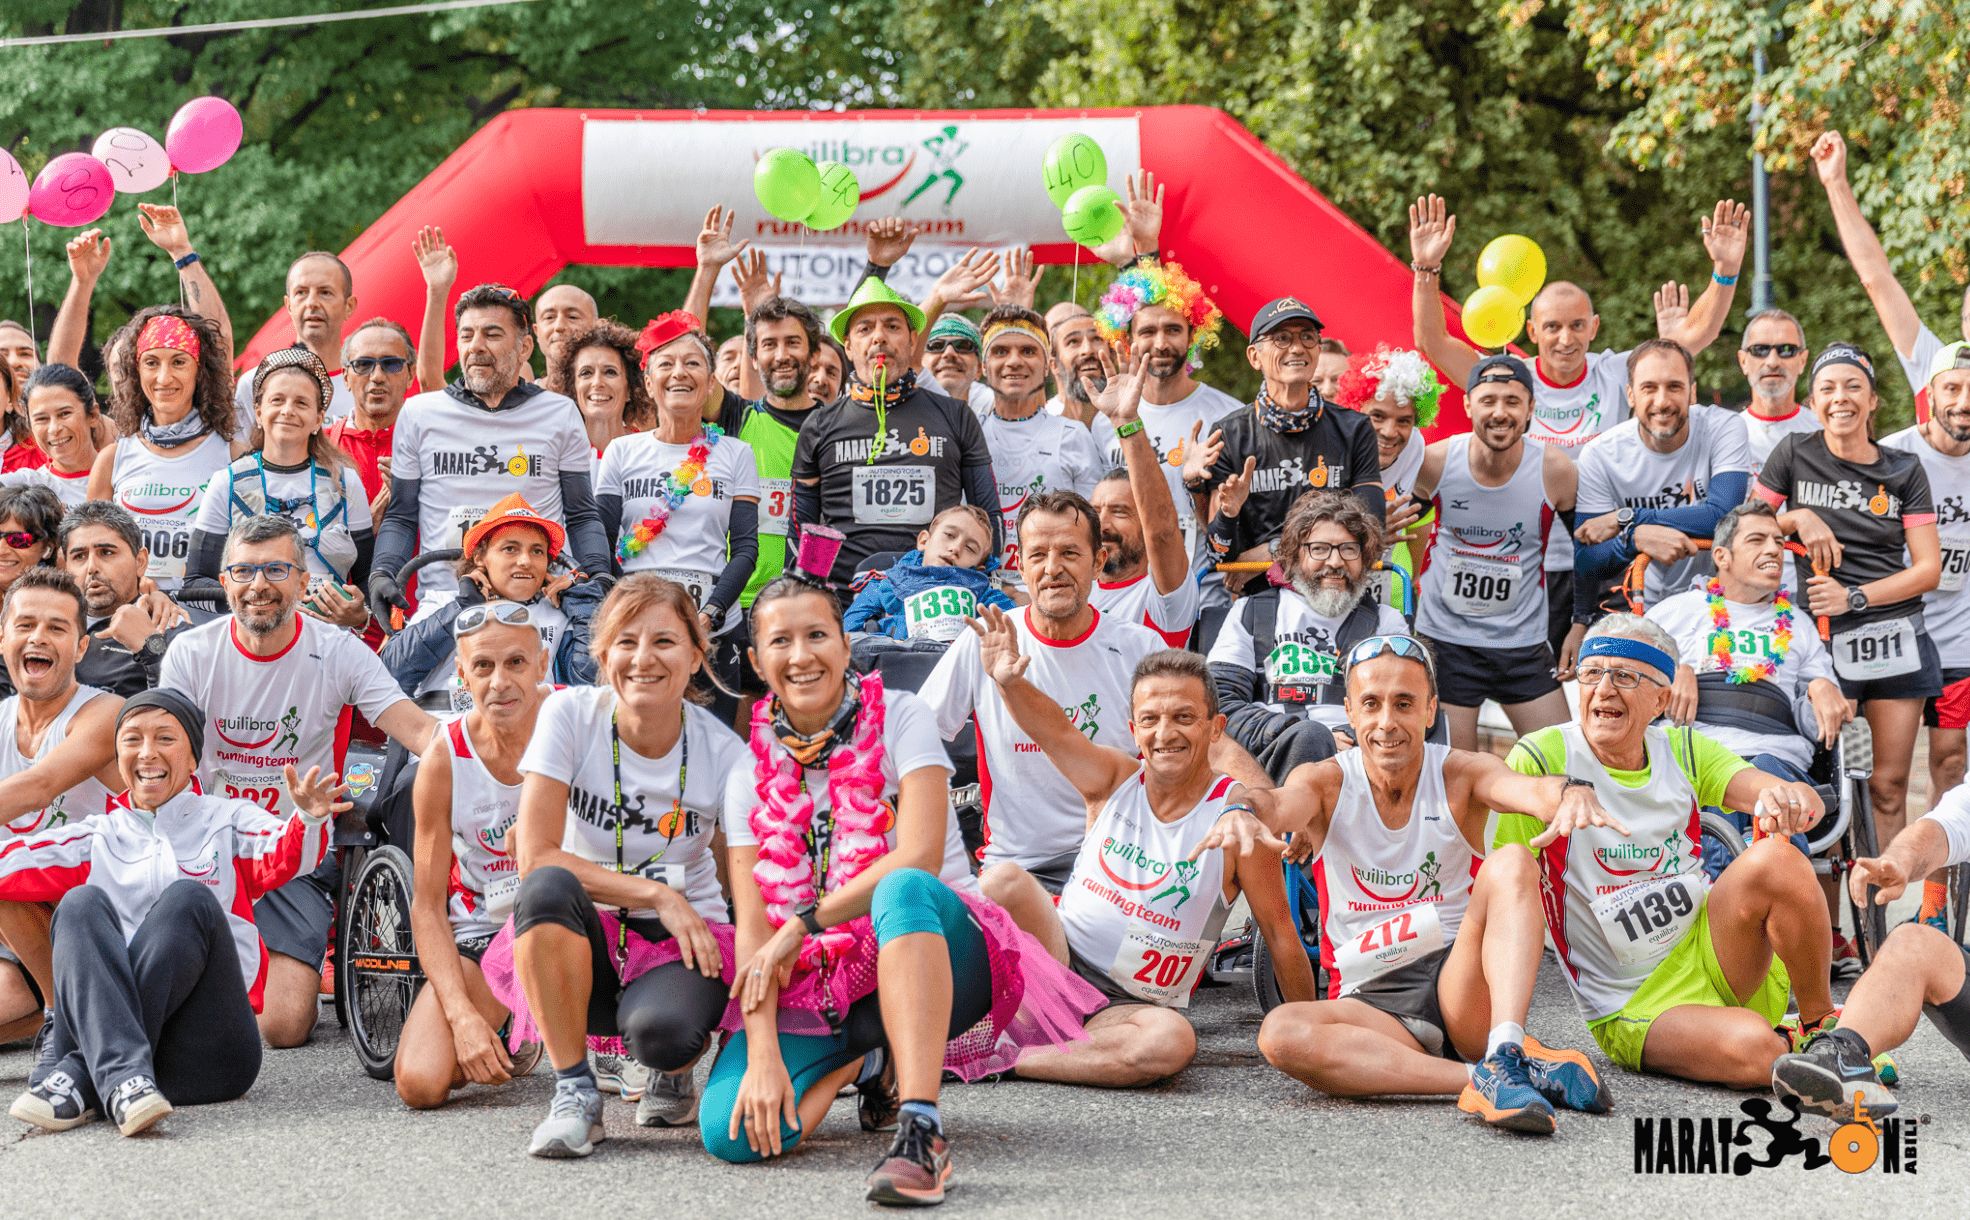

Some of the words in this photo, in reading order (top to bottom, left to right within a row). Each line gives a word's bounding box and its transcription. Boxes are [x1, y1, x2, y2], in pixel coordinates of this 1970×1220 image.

[861, 479, 926, 506] 1825
[1453, 571, 1512, 601] 1309
[908, 588, 974, 622] 1333
[1846, 632, 1903, 663] 1911
[217, 716, 277, 733] equilibra
[217, 750, 264, 768] running
[1102, 836, 1166, 877] equilibra
[1597, 843, 1661, 863] equilibra
[1354, 866, 1415, 886] equilibra
[1081, 876, 1136, 919] running
[1135, 903, 1181, 933] team
[1613, 881, 1694, 943] 1139
[1355, 912, 1418, 954] 272
[1648, 924, 1679, 945] equilibra
[1132, 949, 1194, 988] 207
[1375, 946, 1408, 961] equilibra
